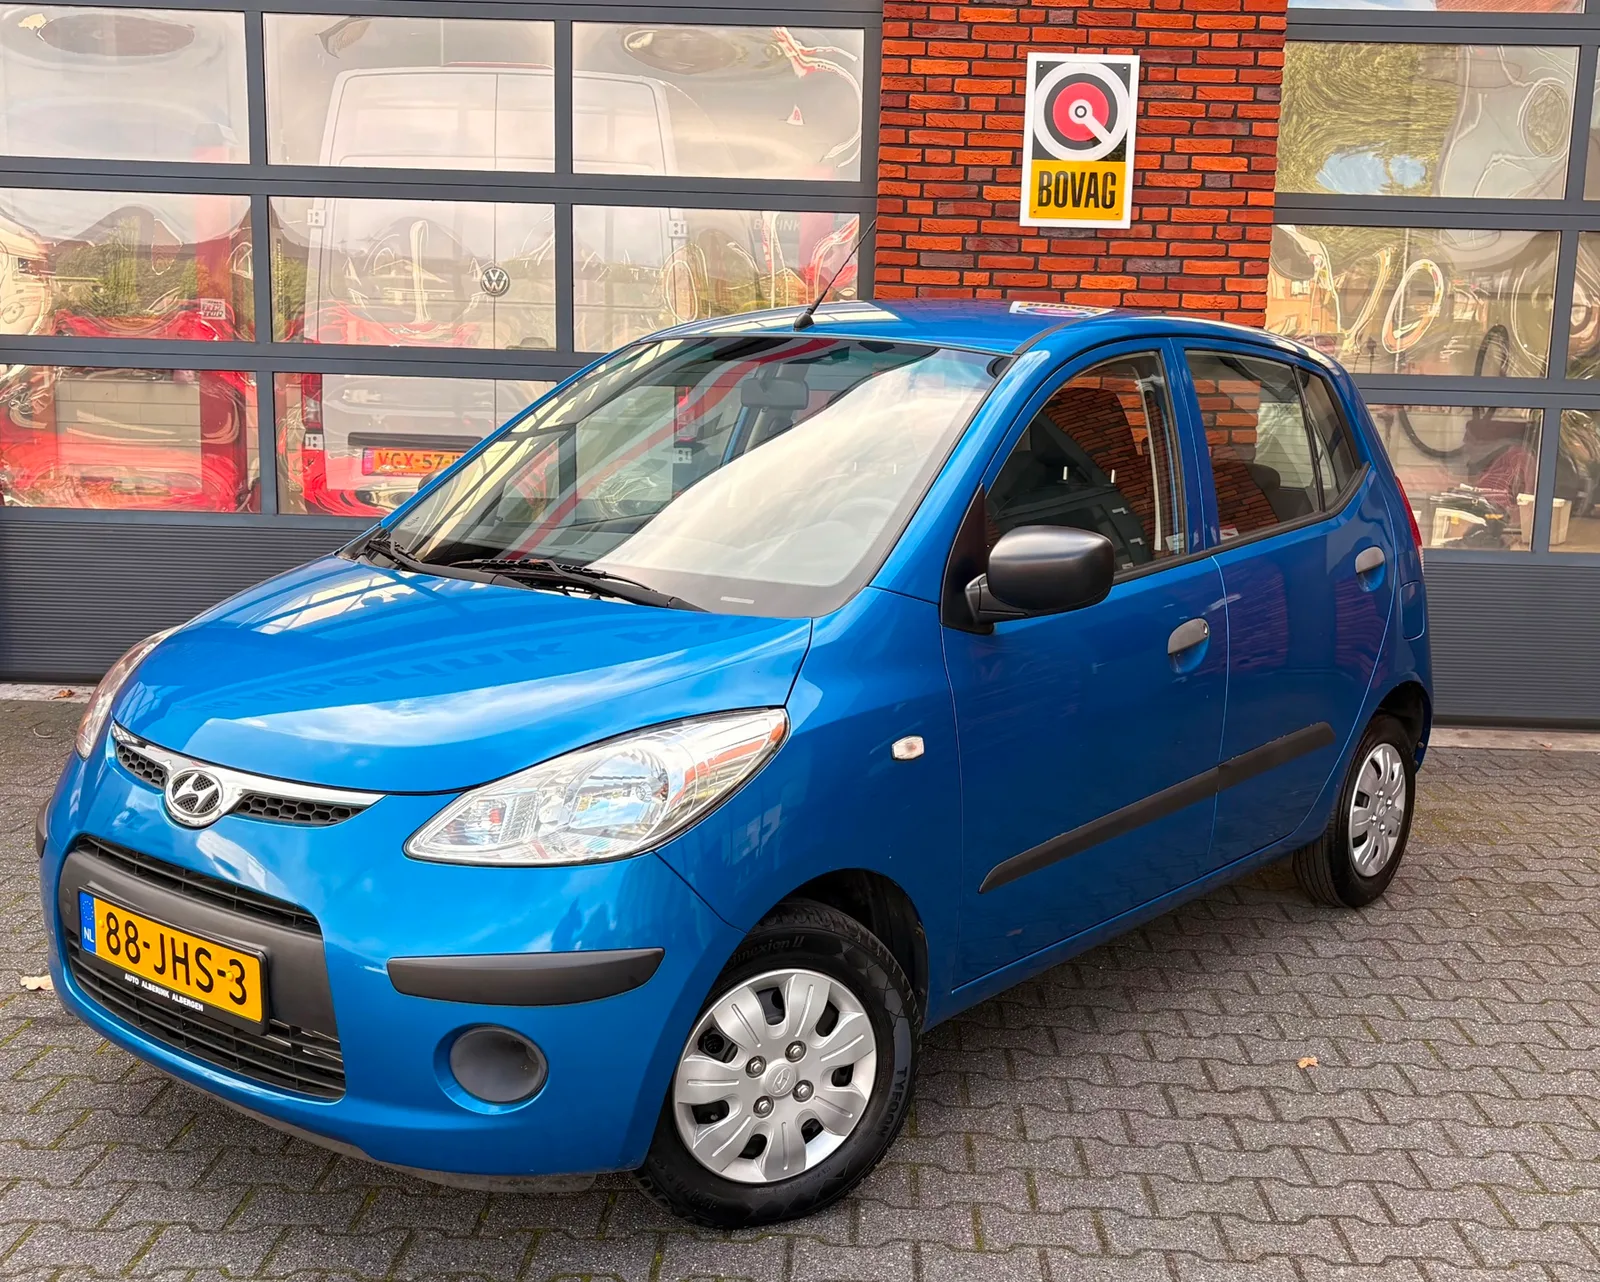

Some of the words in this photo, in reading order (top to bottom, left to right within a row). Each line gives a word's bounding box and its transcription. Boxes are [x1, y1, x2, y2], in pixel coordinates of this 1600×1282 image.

[1037, 171, 1117, 209] BOVAG
[83, 926, 95, 943] NL
[106, 911, 248, 1005] 88-JHS-3
[124, 973, 140, 985] AUTO
[171, 992, 204, 1012] ALBERGEN
